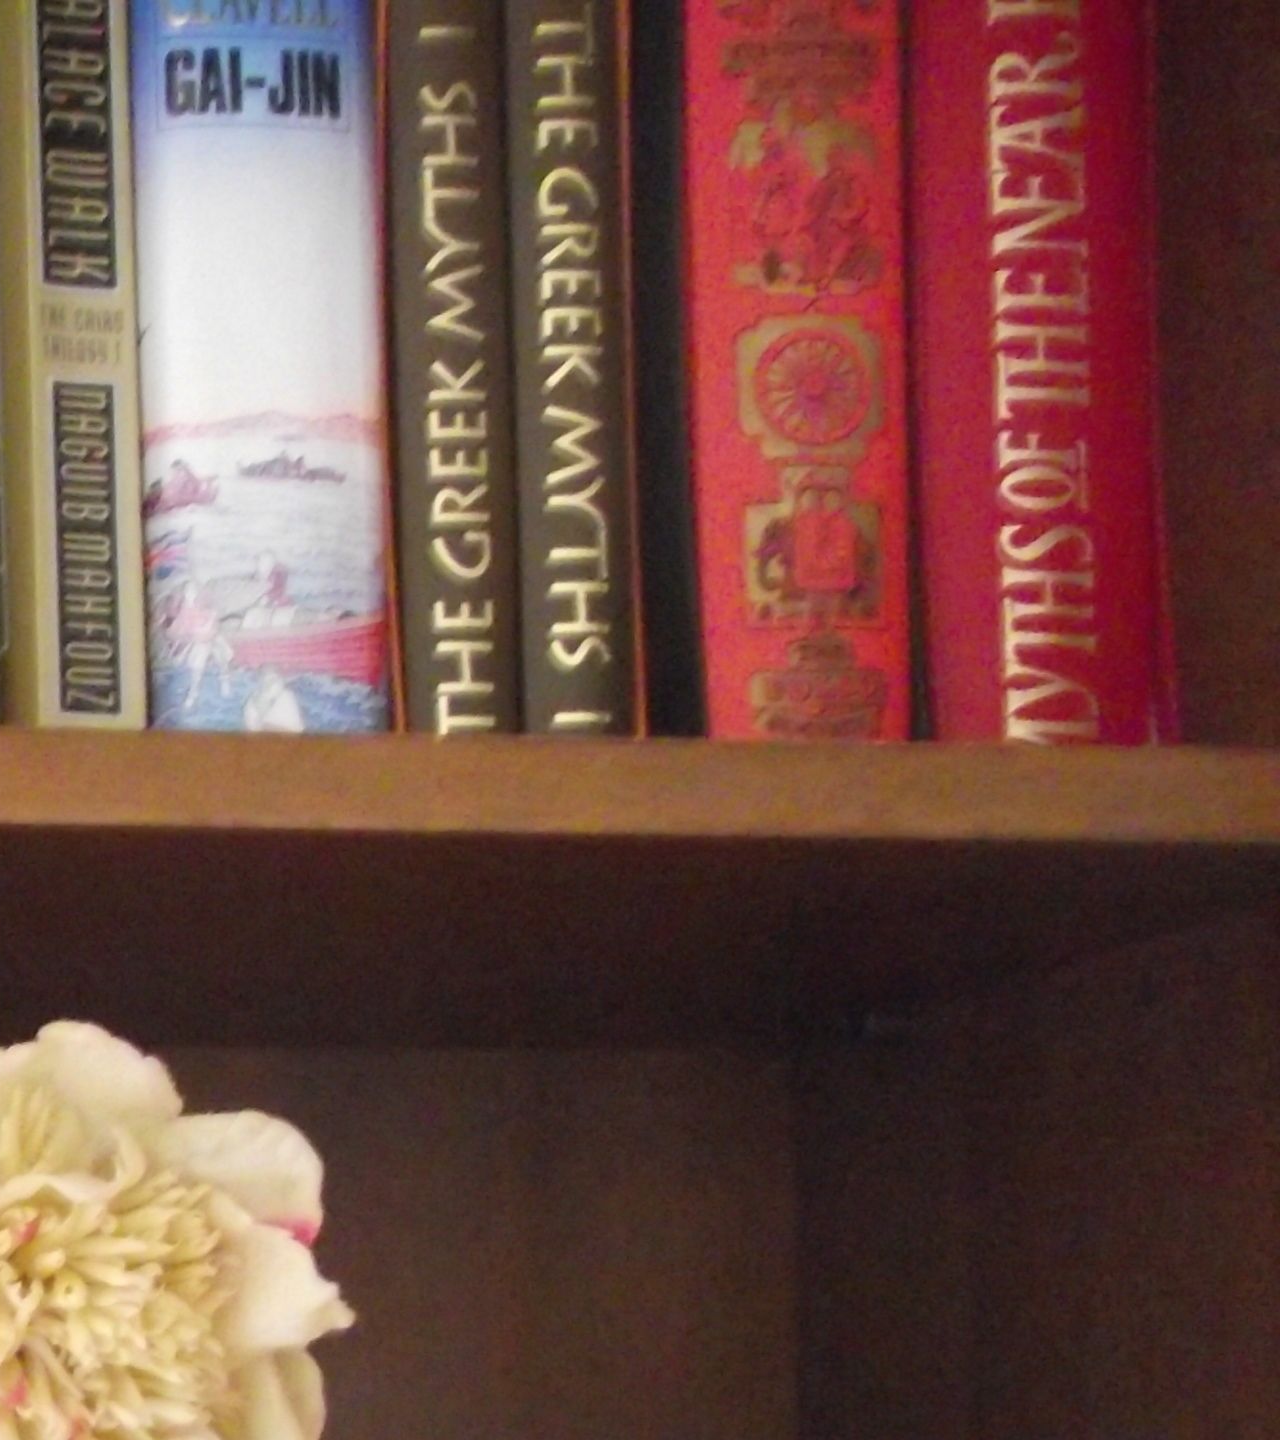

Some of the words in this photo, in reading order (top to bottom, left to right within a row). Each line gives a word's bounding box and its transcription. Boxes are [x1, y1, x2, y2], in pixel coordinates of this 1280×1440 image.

[164, 46, 342, 119] GAI-JIN
[535, 4, 600, 149] THE
[988, 31, 1089, 258] NEAR
[44, 148, 114, 283] WALK
[418, 79, 486, 343] MYTHS
[538, 165, 605, 395] GREEK
[993, 268, 1090, 420] THE
[59, 386, 112, 522] NAGUIB
[425, 357, 490, 580] GREEK
[997, 431, 1090, 513] OF
[542, 404, 611, 669] MYTHS
[63, 530, 116, 709] MAHFOUZ
[433, 600, 497, 738] THE
